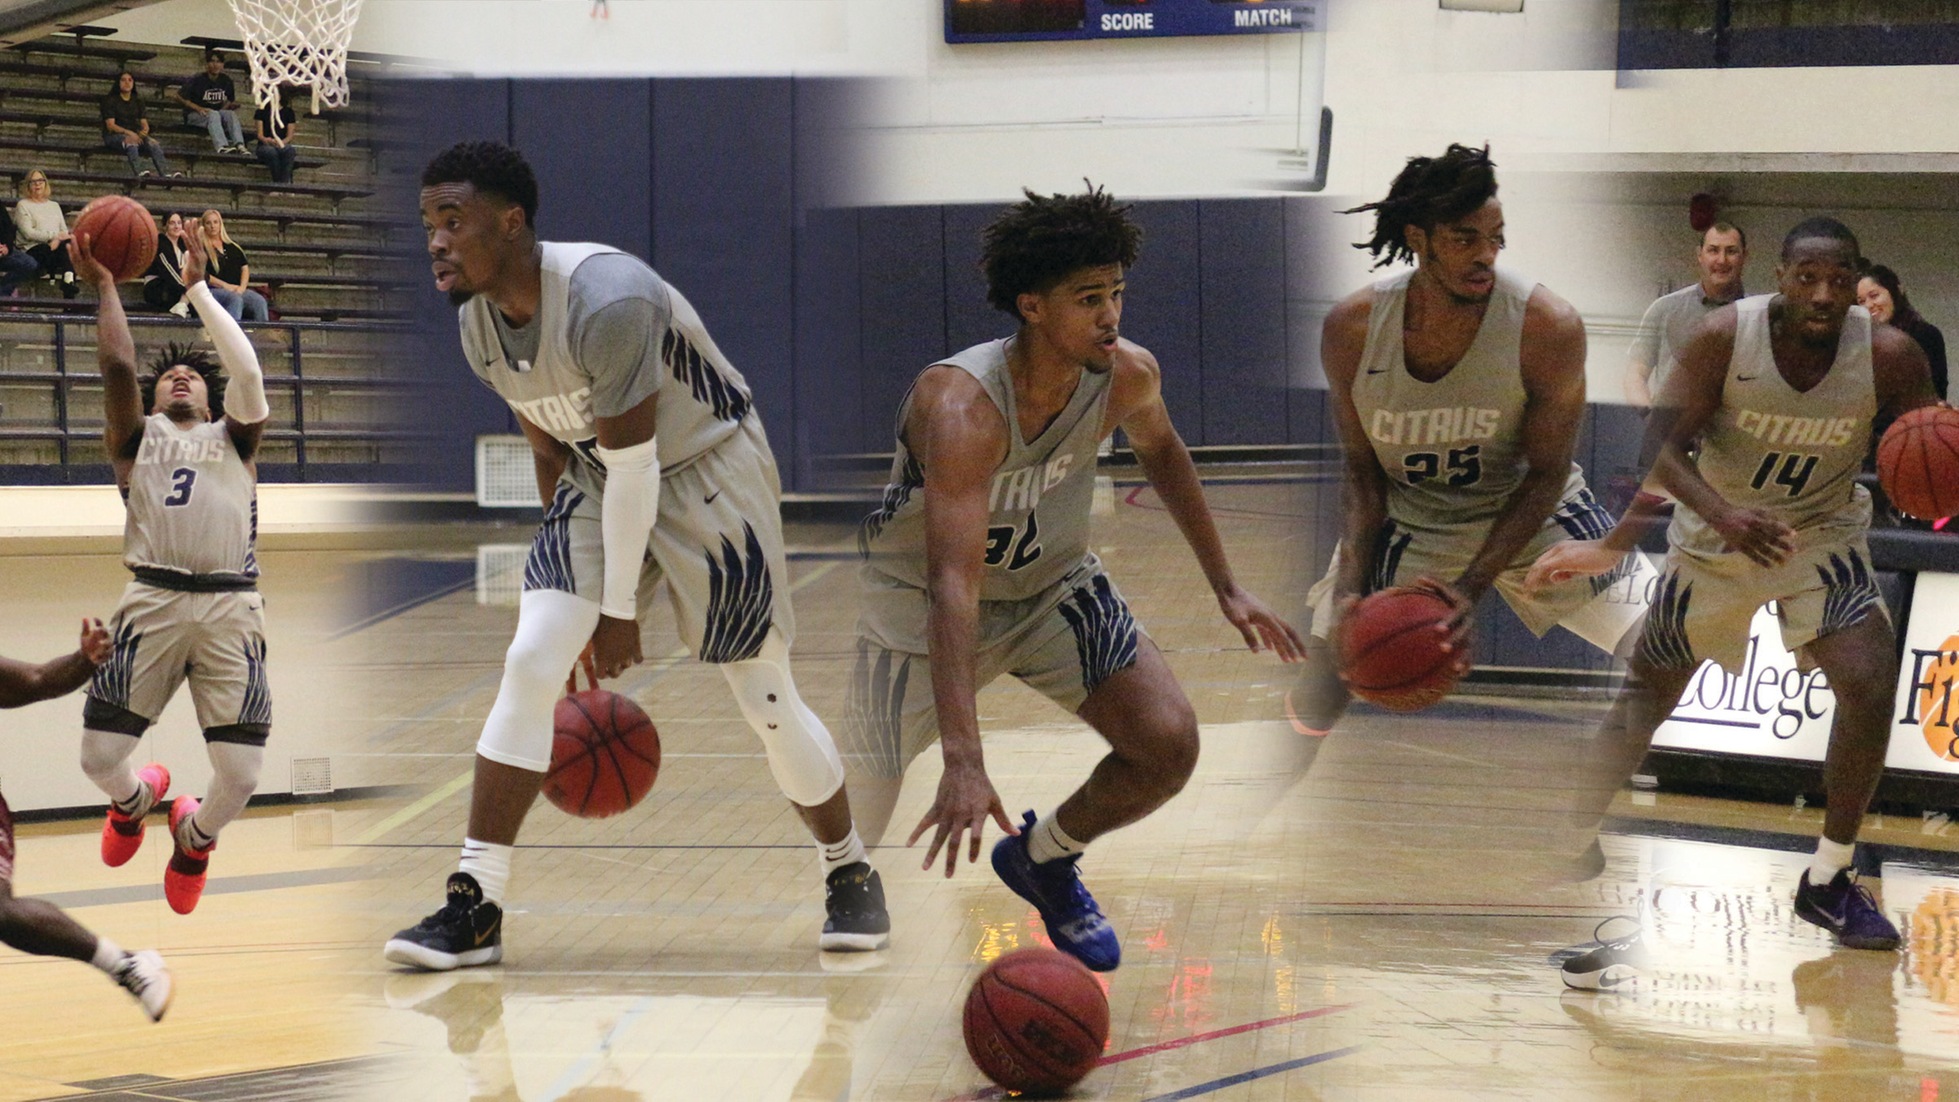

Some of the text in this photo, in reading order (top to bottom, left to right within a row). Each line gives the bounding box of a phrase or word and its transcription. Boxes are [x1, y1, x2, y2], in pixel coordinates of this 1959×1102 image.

[1101, 13, 1154, 31] SCORE
[1235, 9, 1292, 27] MATCH
[507, 387, 594, 431] ITRUS
[1372, 407, 1500, 444] CITRUS
[1736, 410, 1857, 446] CITRUS
[136, 437, 226, 465] CITRUS
[164, 467, 197, 508] 3
[1750, 451, 1822, 497] 14
